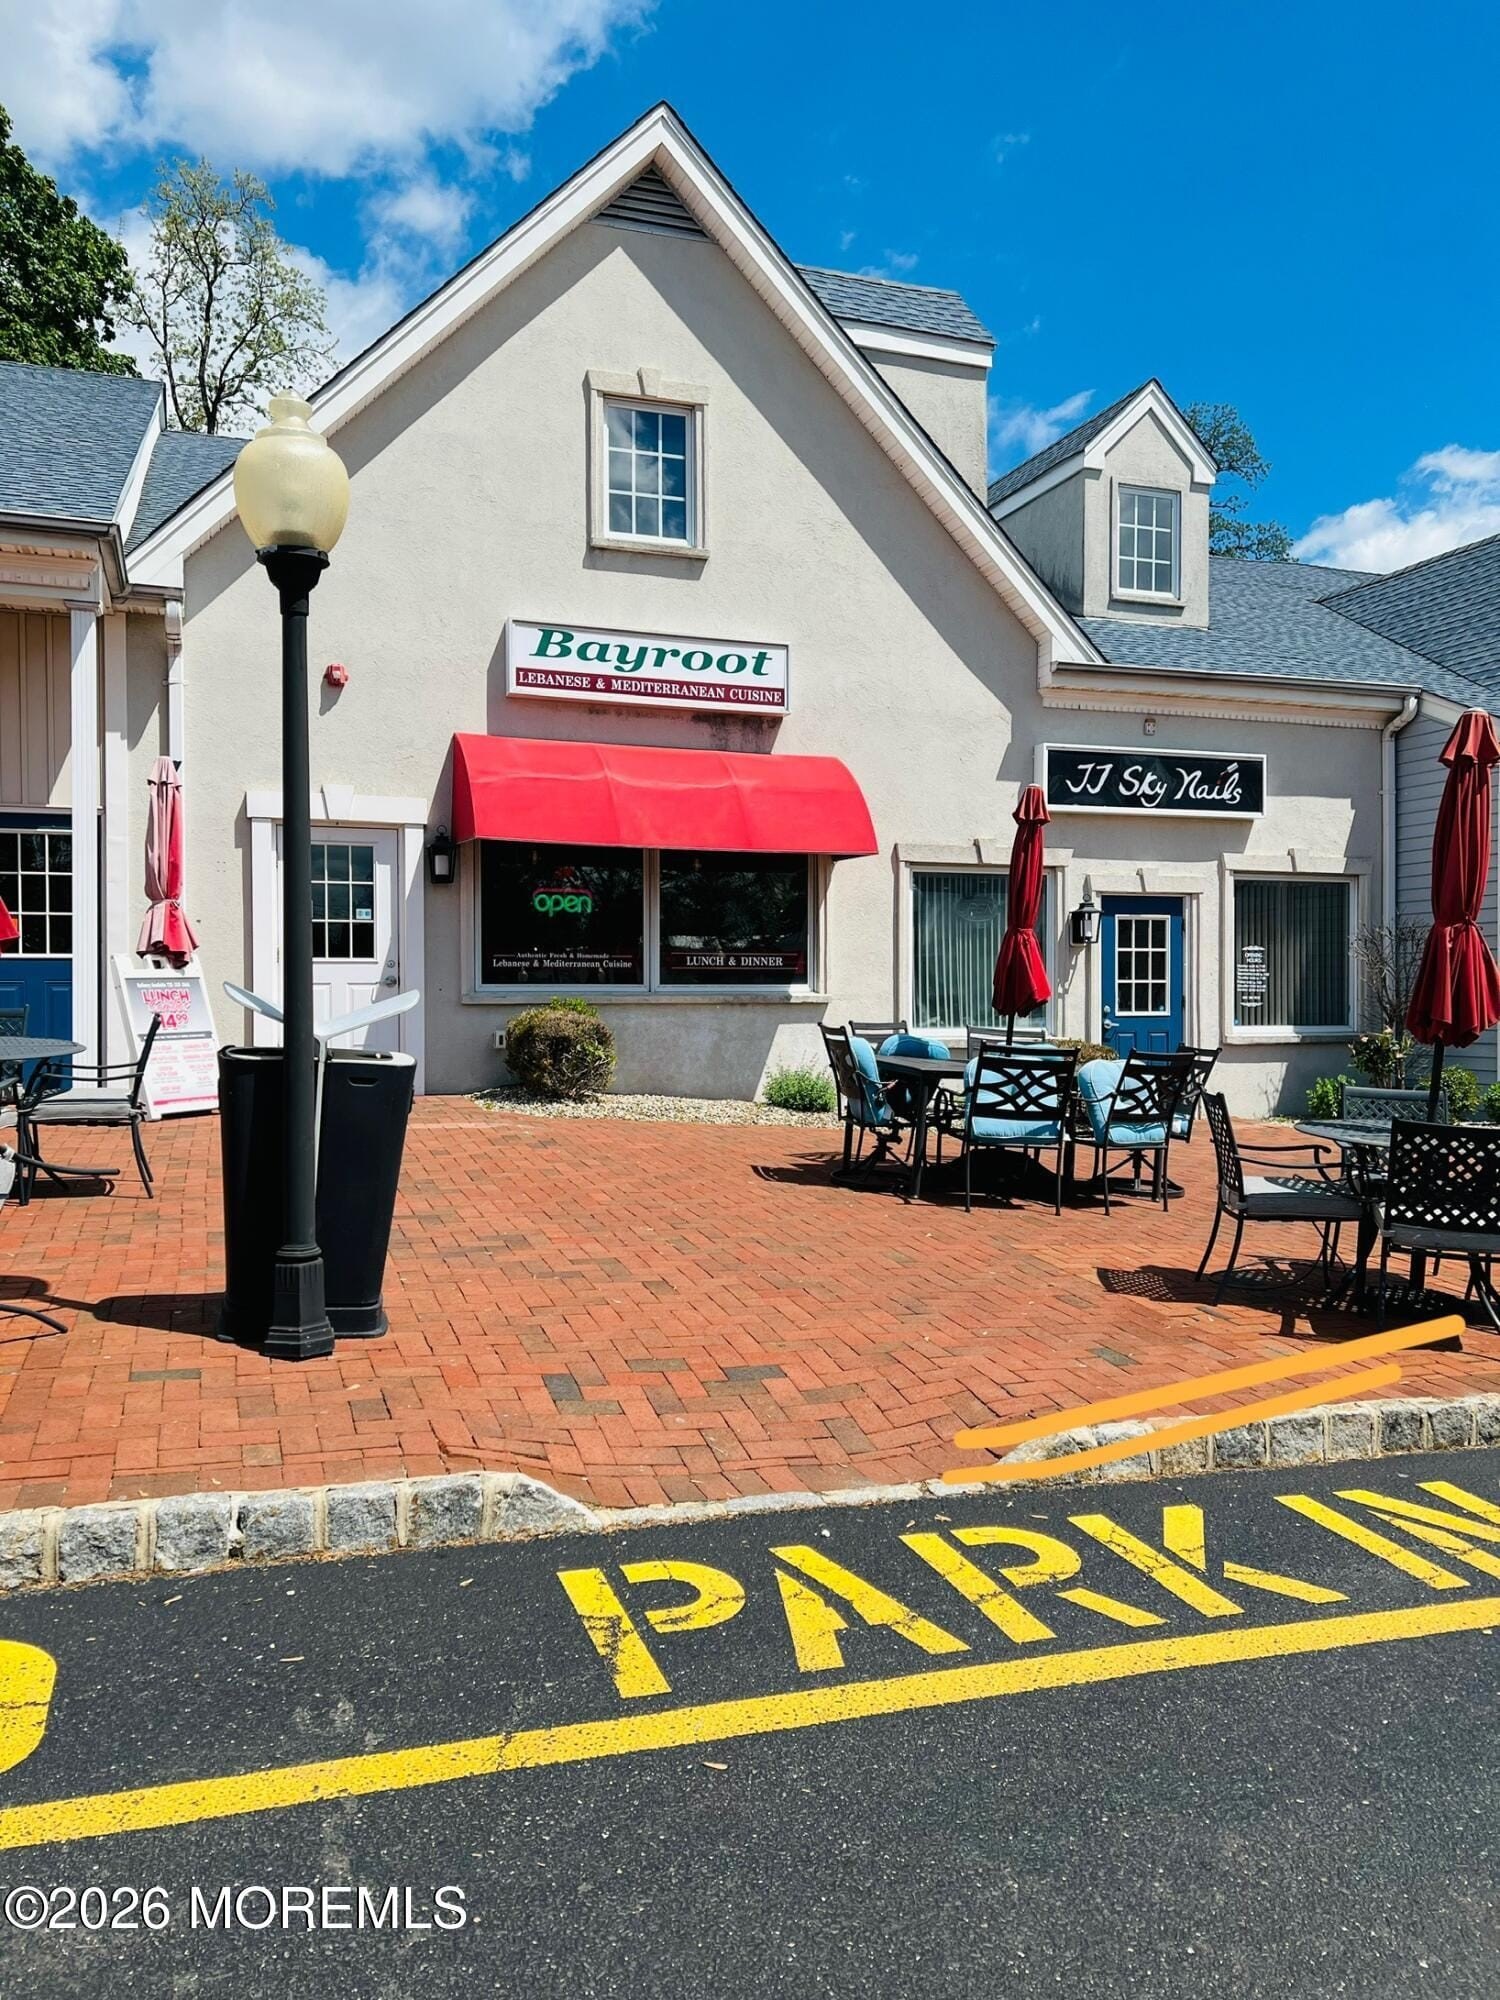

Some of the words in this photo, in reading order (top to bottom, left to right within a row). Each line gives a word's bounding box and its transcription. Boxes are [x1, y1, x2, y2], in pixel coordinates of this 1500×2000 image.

[528, 628, 773, 676] Bayroot
[518, 671, 591, 688] LEBANESE
[596, 676, 606, 689] &
[611, 678, 725, 698] MEDITERRANEAN
[729, 687, 782, 703] CUISINE
[1118, 765, 1167, 807] Sky
[1174, 765, 1242, 805] Nails
[534, 893, 592, 918] open
[493, 959, 530, 967] Lebanese
[533, 959, 539, 968] &
[543, 959, 600, 968] Mediterranean
[603, 960, 632, 968] Cuisine
[686, 956, 724, 966] LUNCH
[728, 956, 736, 966] &
[741, 957, 783, 967] DINNER
[142, 990, 190, 1003] LUNCH
